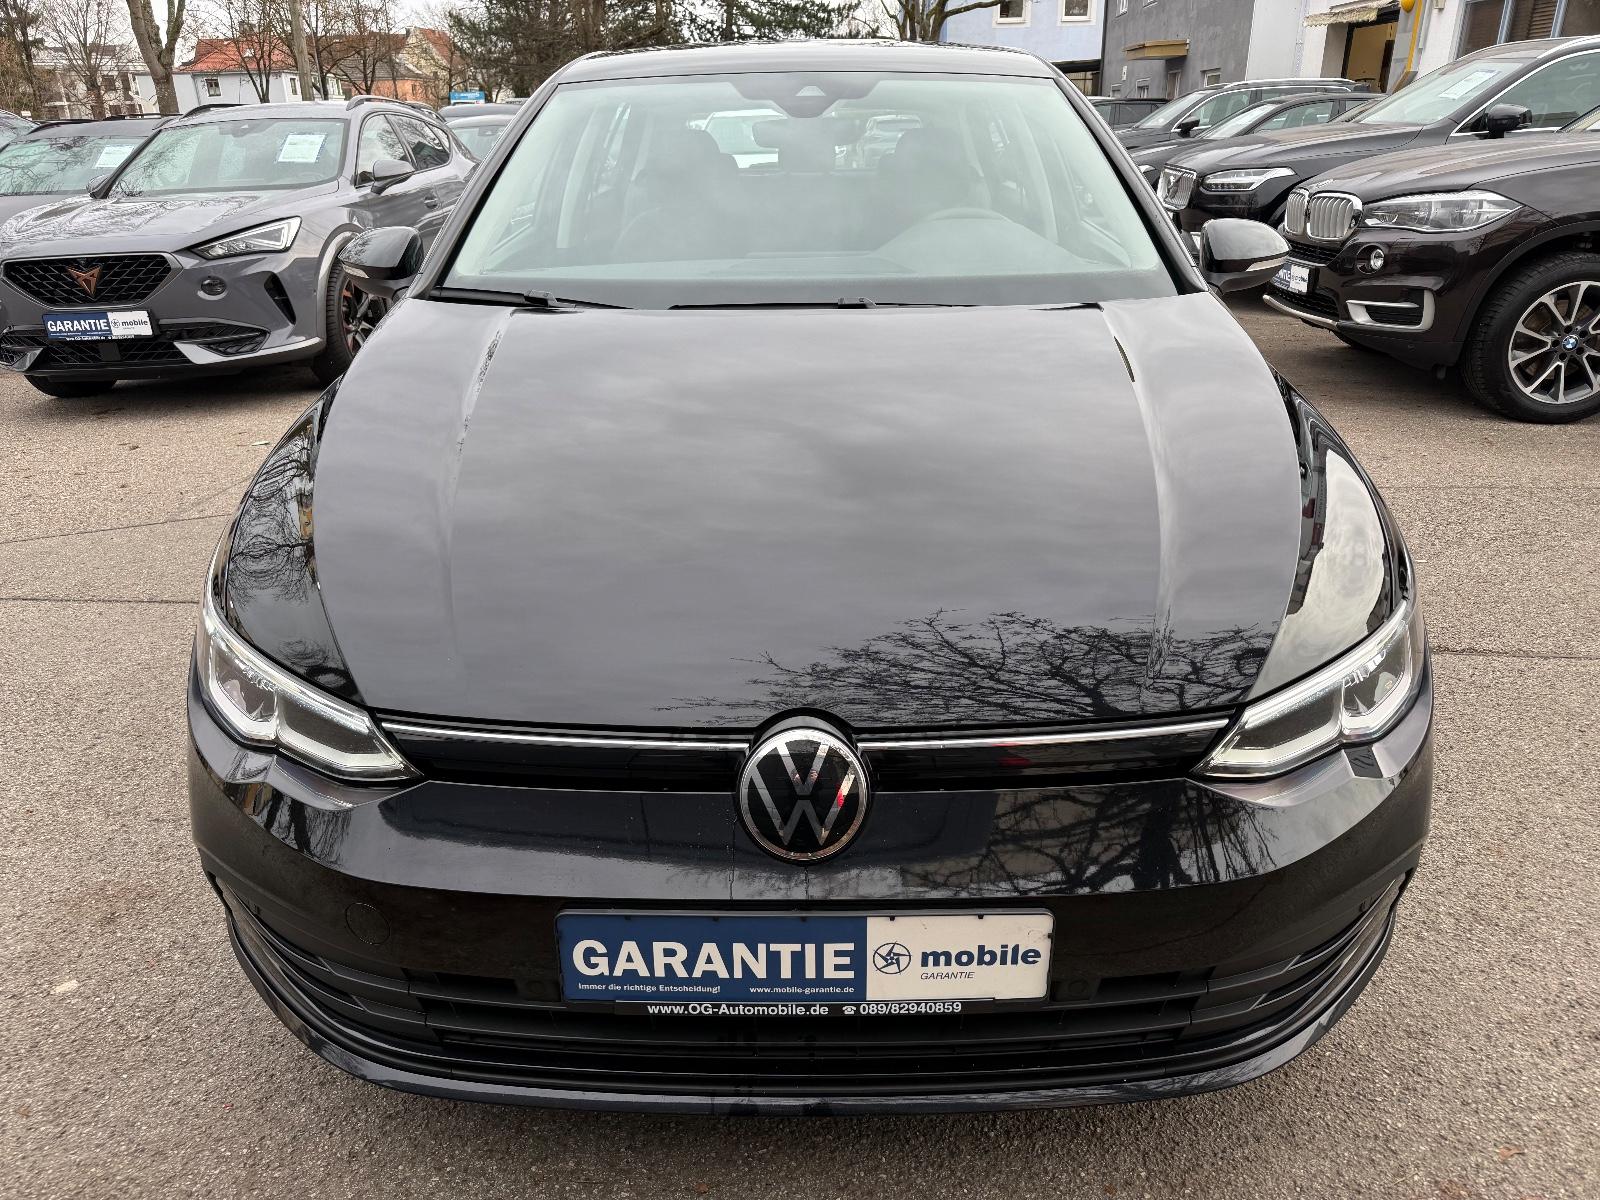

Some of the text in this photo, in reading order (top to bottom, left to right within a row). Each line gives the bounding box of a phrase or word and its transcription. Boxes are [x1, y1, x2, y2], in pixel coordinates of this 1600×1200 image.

[47, 319, 110, 331] GARANTIE
[121, 319, 148, 327] mobile
[572, 939, 855, 979] GARANTIE
[920, 943, 1042, 968] mobile
[920, 971, 975, 980] GARANTIE
[578, 982, 721, 993] Immer die richtige Entscheidung!
[749, 986, 855, 995] www.mobile-garantie.de
[647, 1003, 829, 1016] www.OG-Automobile.de
[859, 1001, 962, 1015] 089/82940859
